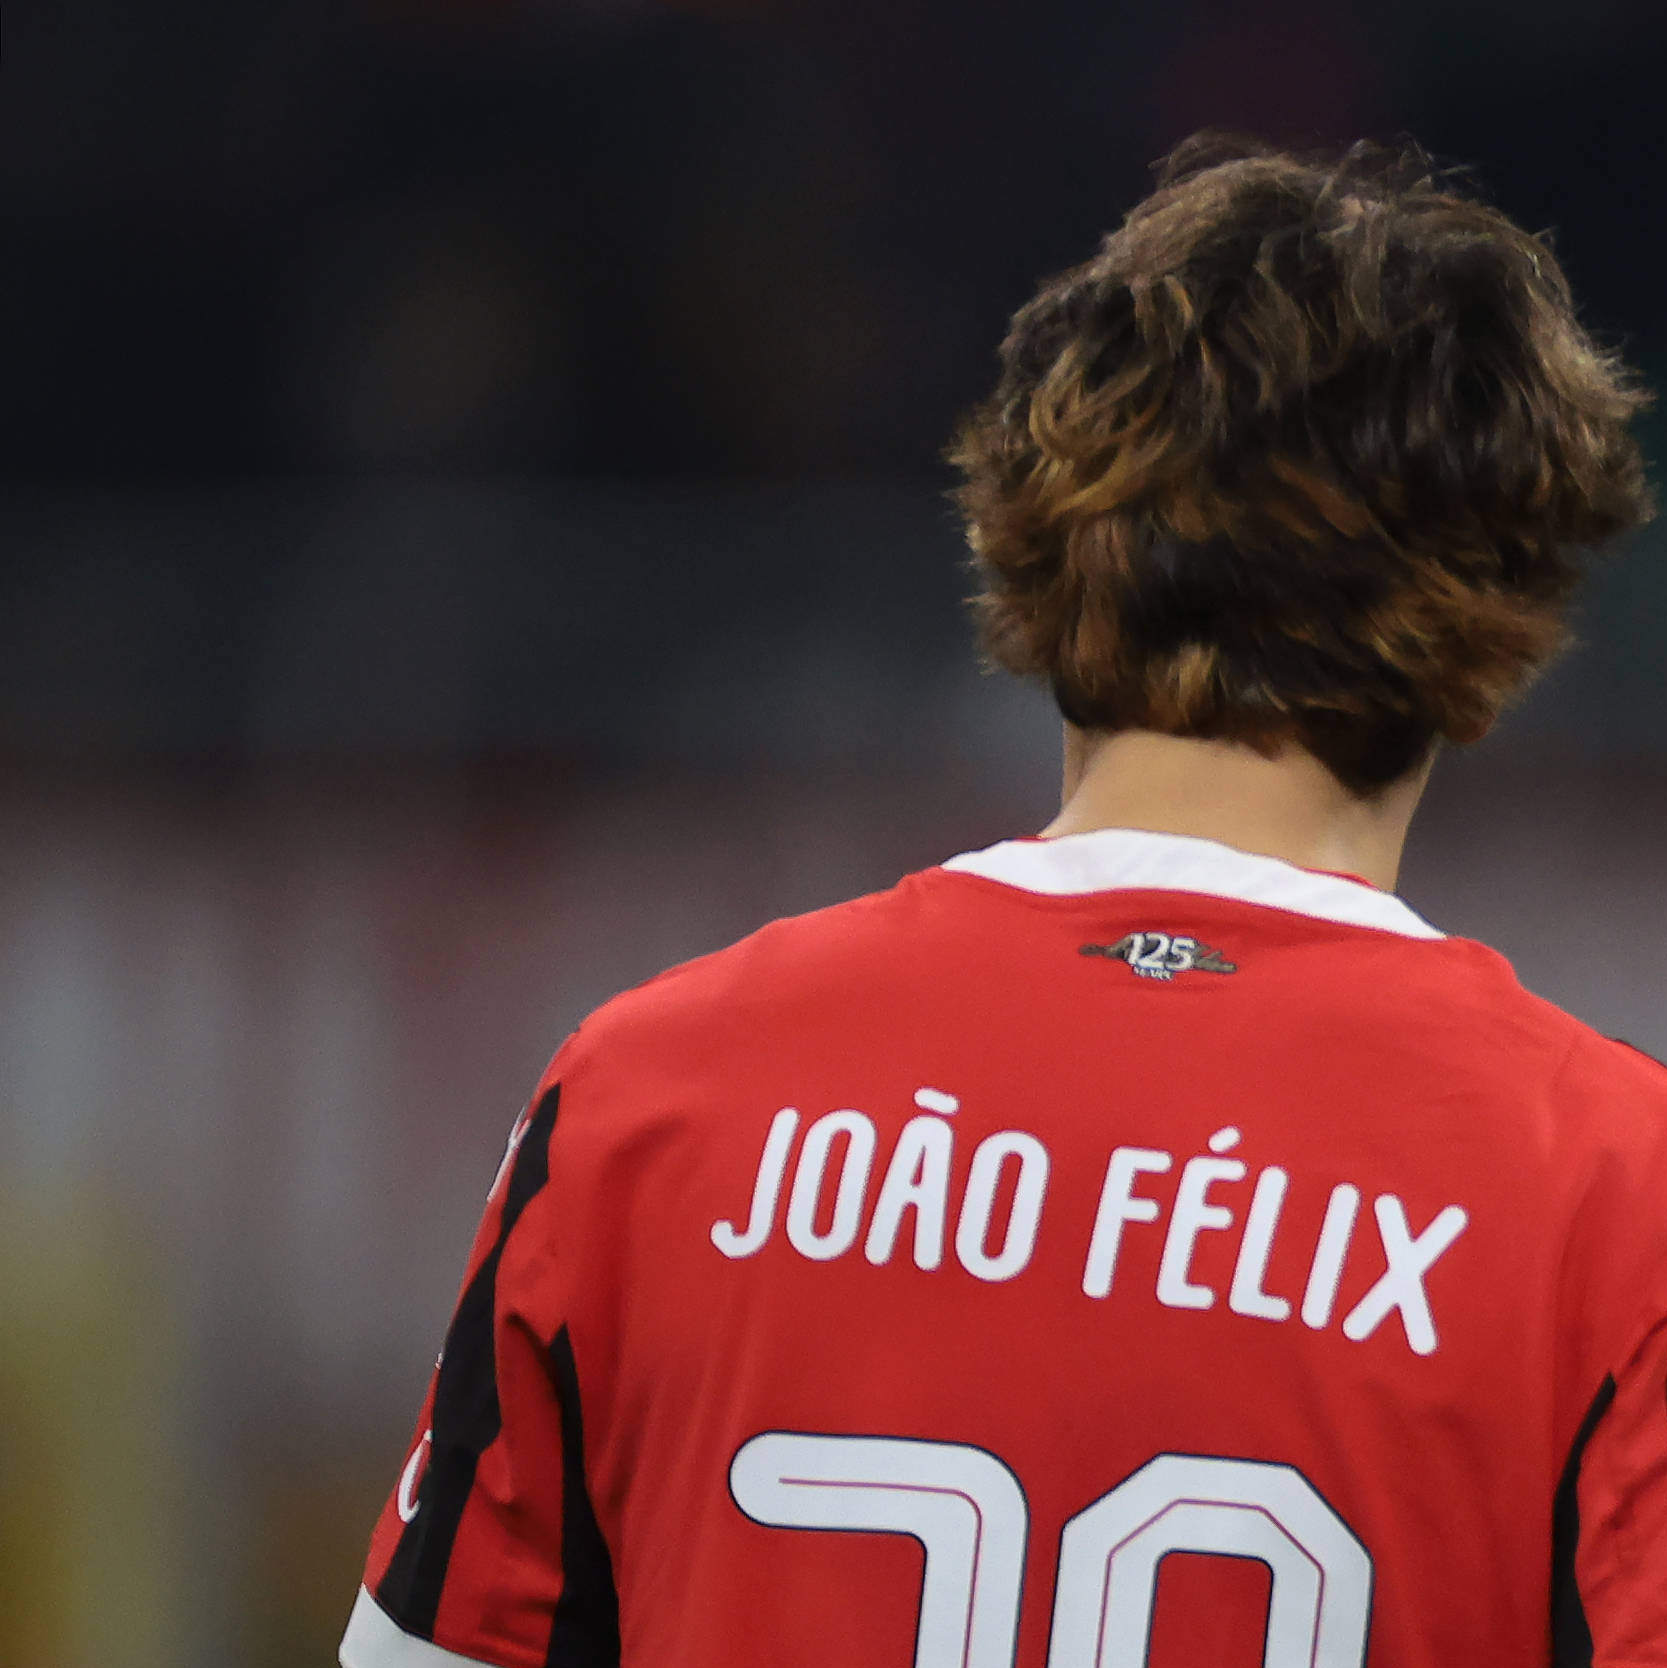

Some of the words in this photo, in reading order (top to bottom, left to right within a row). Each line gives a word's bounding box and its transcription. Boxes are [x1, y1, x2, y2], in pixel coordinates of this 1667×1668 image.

[1127, 932, 1195, 971] 125
[709, 1087, 1050, 1282] JOÃO
[1081, 1126, 1469, 1356] FÉLIX
